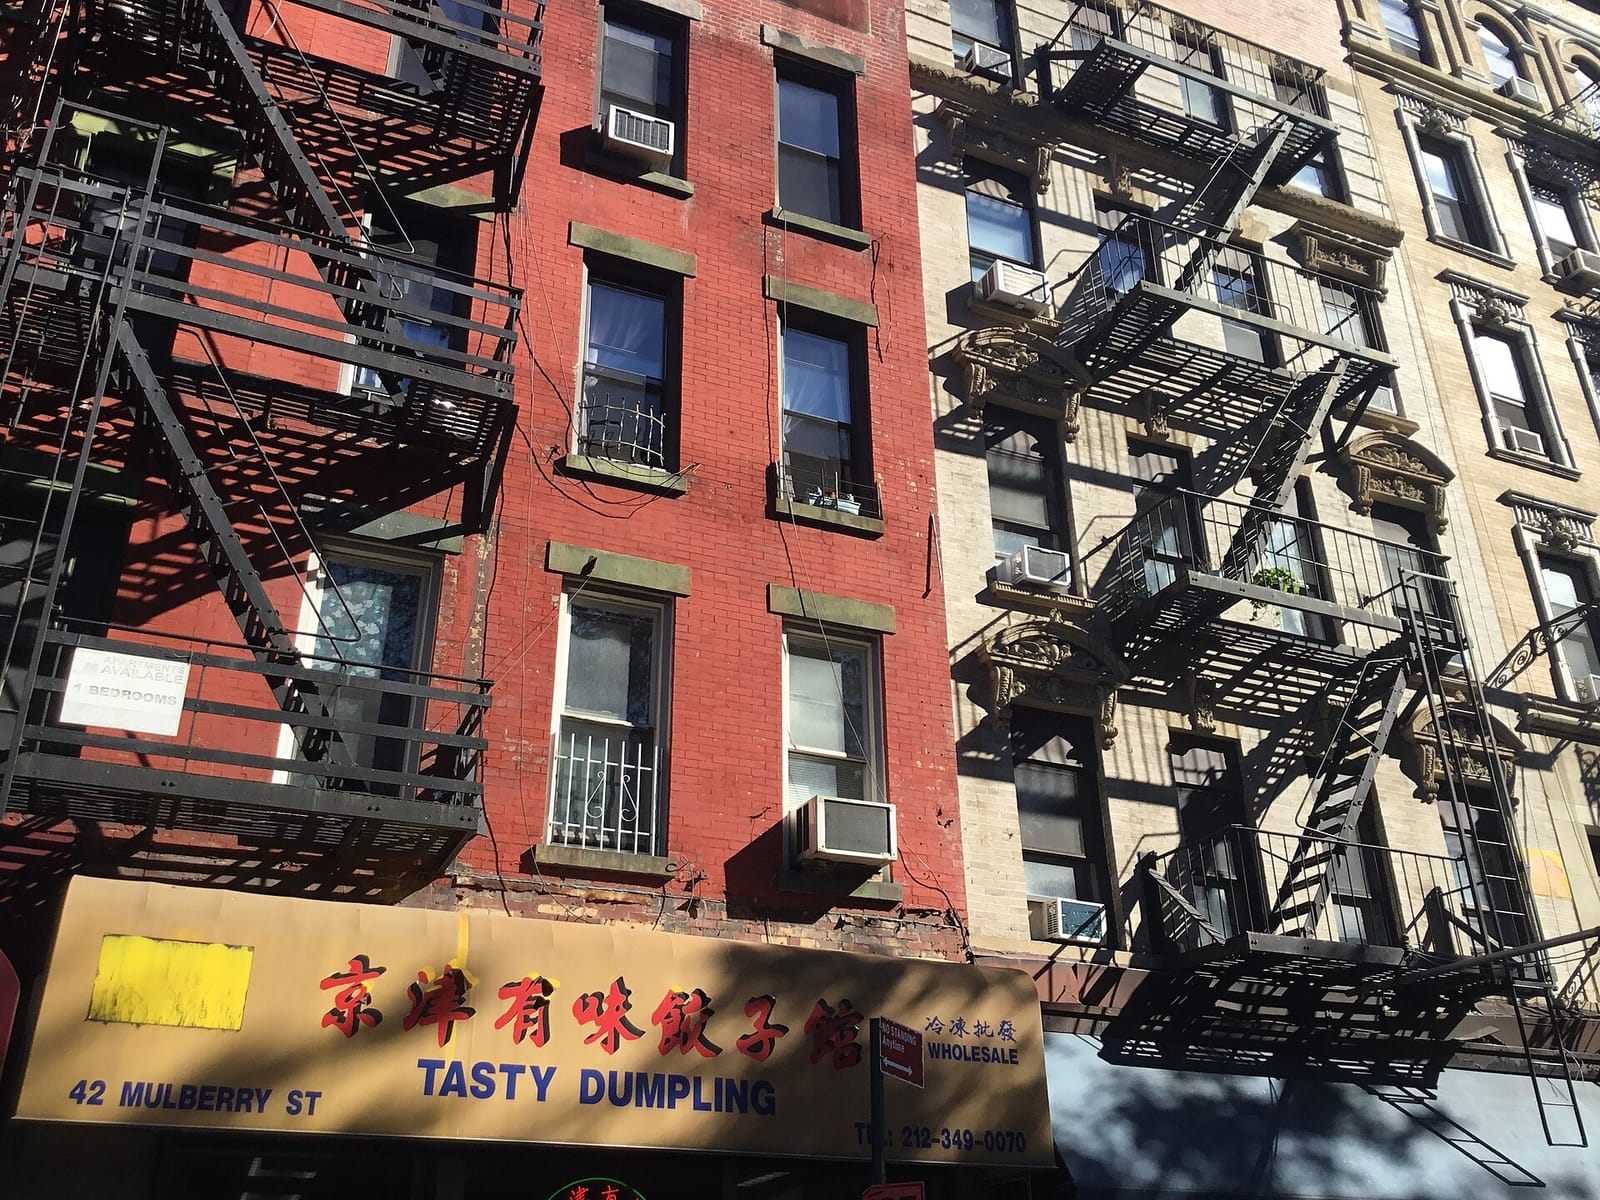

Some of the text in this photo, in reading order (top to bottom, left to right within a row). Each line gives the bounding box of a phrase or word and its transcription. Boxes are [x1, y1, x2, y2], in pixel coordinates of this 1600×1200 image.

[100, 664, 185, 685] AVAILABLE
[103, 655, 186, 676] APARTMENTS
[88, 685, 178, 706] BEDROOMS
[891, 1026, 917, 1047] STANDING
[925, 1015, 1018, 1043] 冷凍批發
[882, 1034, 905, 1054] Anytime
[927, 1041, 1020, 1065] WHOLESALE
[69, 1079, 323, 1116] 42 MULBERRY ST
[417, 1058, 776, 1116] TASTY DUMPLING
[901, 1126, 1027, 1153] 212-349-0070
